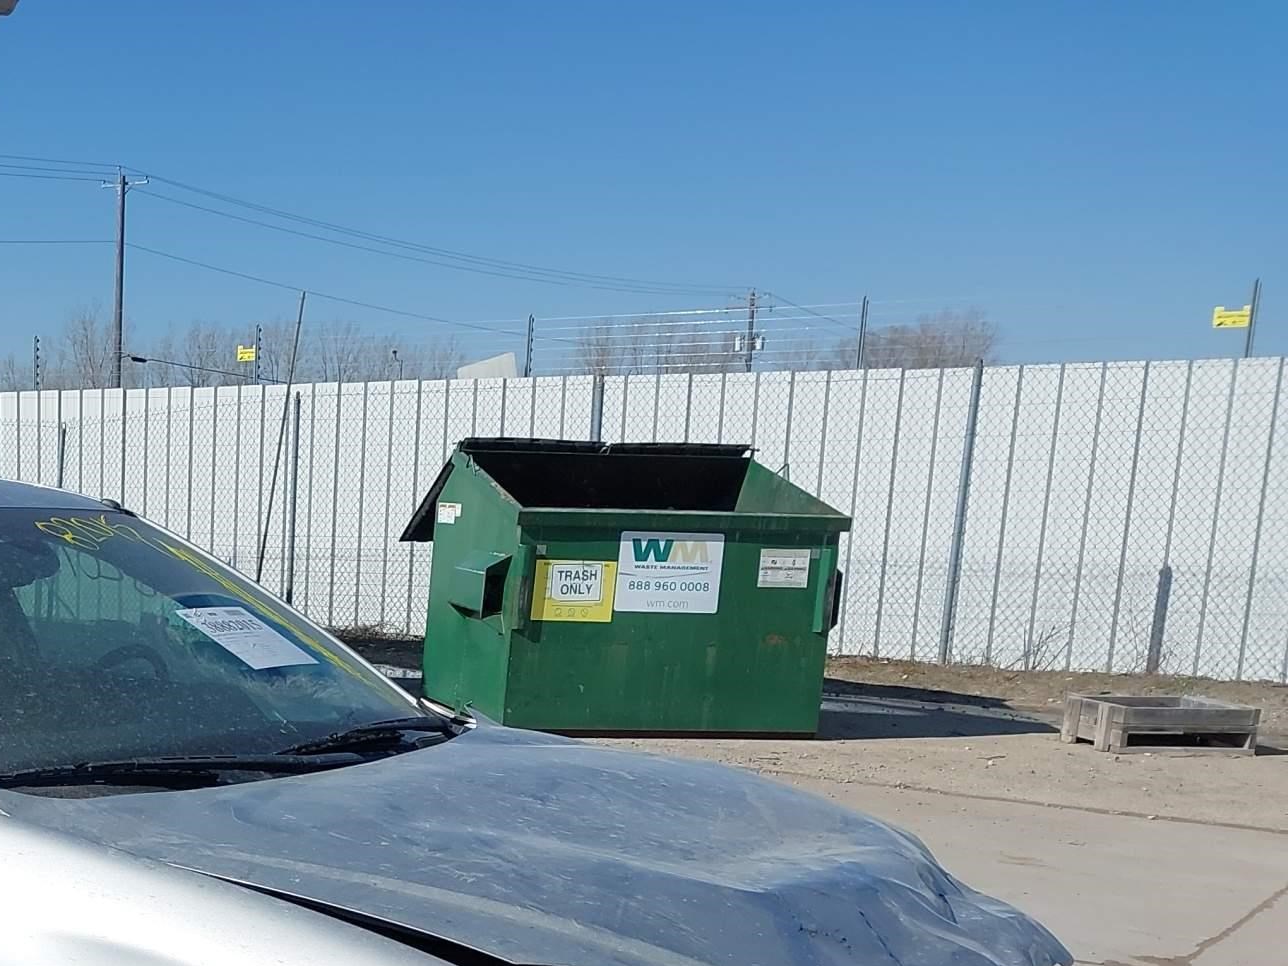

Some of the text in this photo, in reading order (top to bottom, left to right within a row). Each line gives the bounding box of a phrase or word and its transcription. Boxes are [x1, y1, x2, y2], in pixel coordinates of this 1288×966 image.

[632, 538, 712, 563] WM
[557, 569, 598, 582] TRASH
[560, 583, 593, 595] ONLY
[628, 580, 710, 592] 888 960 0008
[646, 599, 689, 609] wm.com
